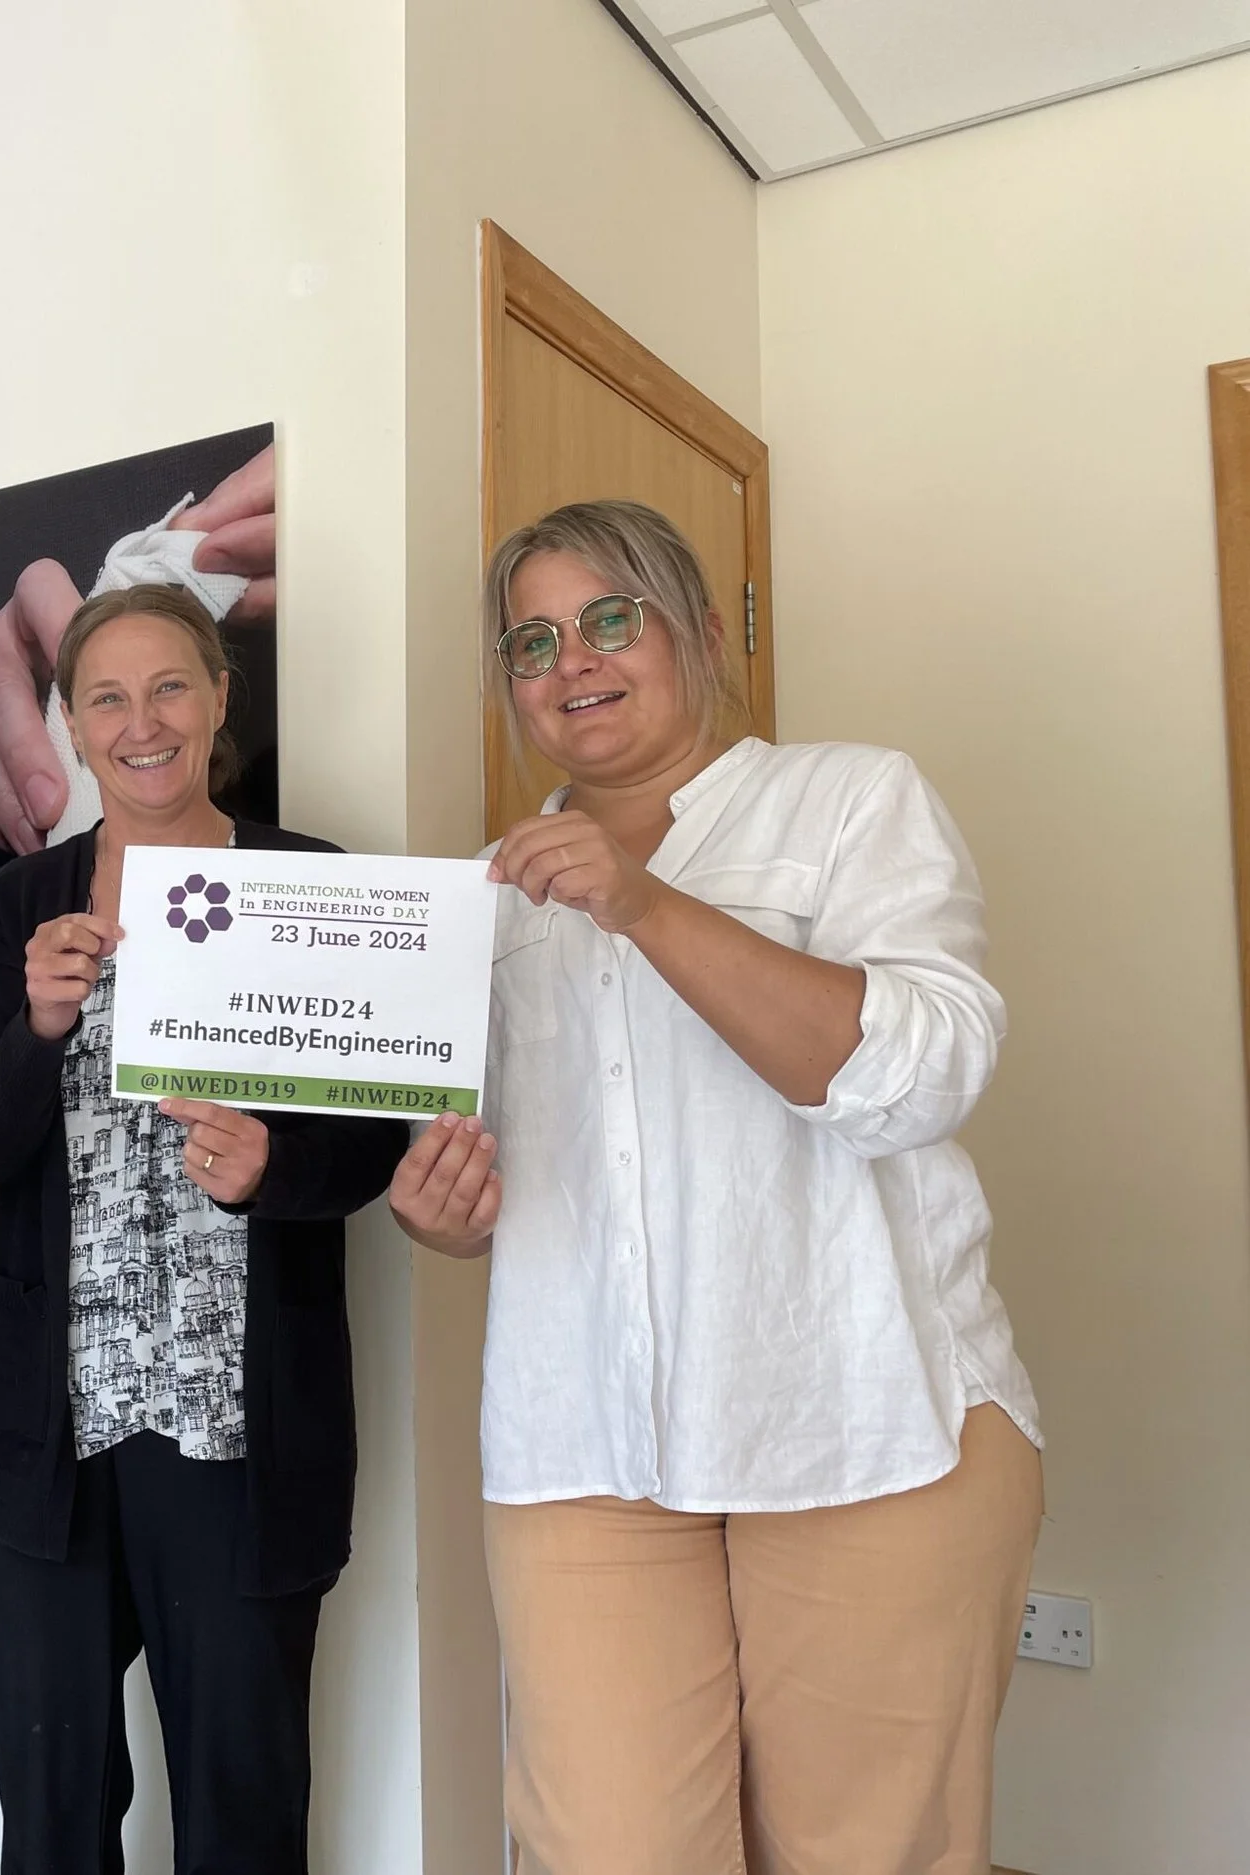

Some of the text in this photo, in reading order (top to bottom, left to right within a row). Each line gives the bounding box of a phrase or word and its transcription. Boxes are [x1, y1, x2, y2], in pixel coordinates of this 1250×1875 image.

[240, 881, 430, 903] INTERNATIONAL WOMEN
[239, 898, 430, 919] In ENGINEERING DAY
[271, 924, 428, 951] 23 June 2024
[228, 992, 374, 1020] #INWED24
[148, 1018, 453, 1063] #EnhancedByEngineering
[140, 1072, 450, 1109] @INWED1919 #INWED24
